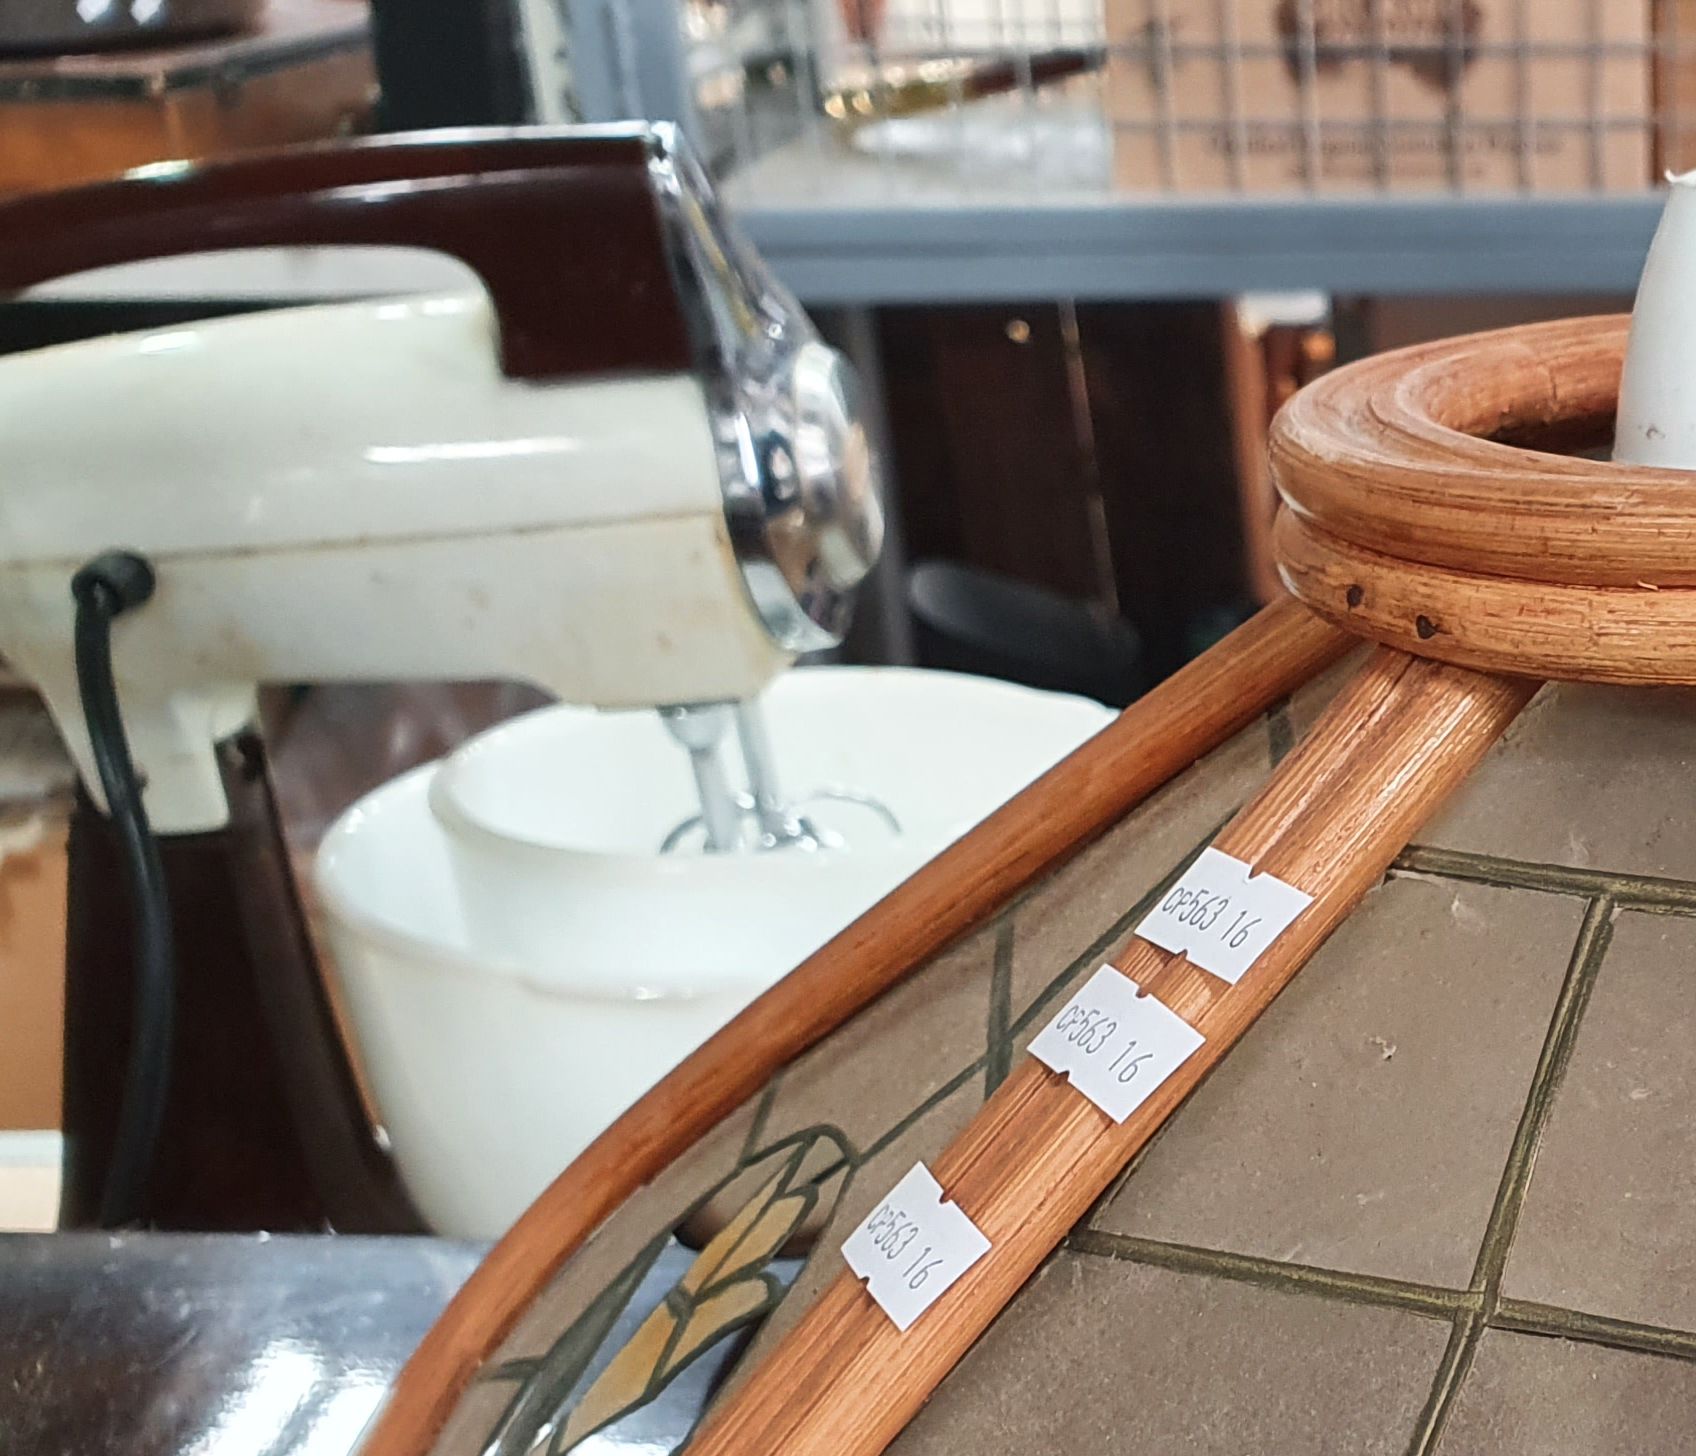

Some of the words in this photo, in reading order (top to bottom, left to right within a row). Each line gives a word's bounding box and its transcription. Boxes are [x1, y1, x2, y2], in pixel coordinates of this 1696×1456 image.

[1220, 910, 1262, 948] 16
[1108, 1040, 1153, 1083] 16
[902, 1246, 944, 1290] 16
